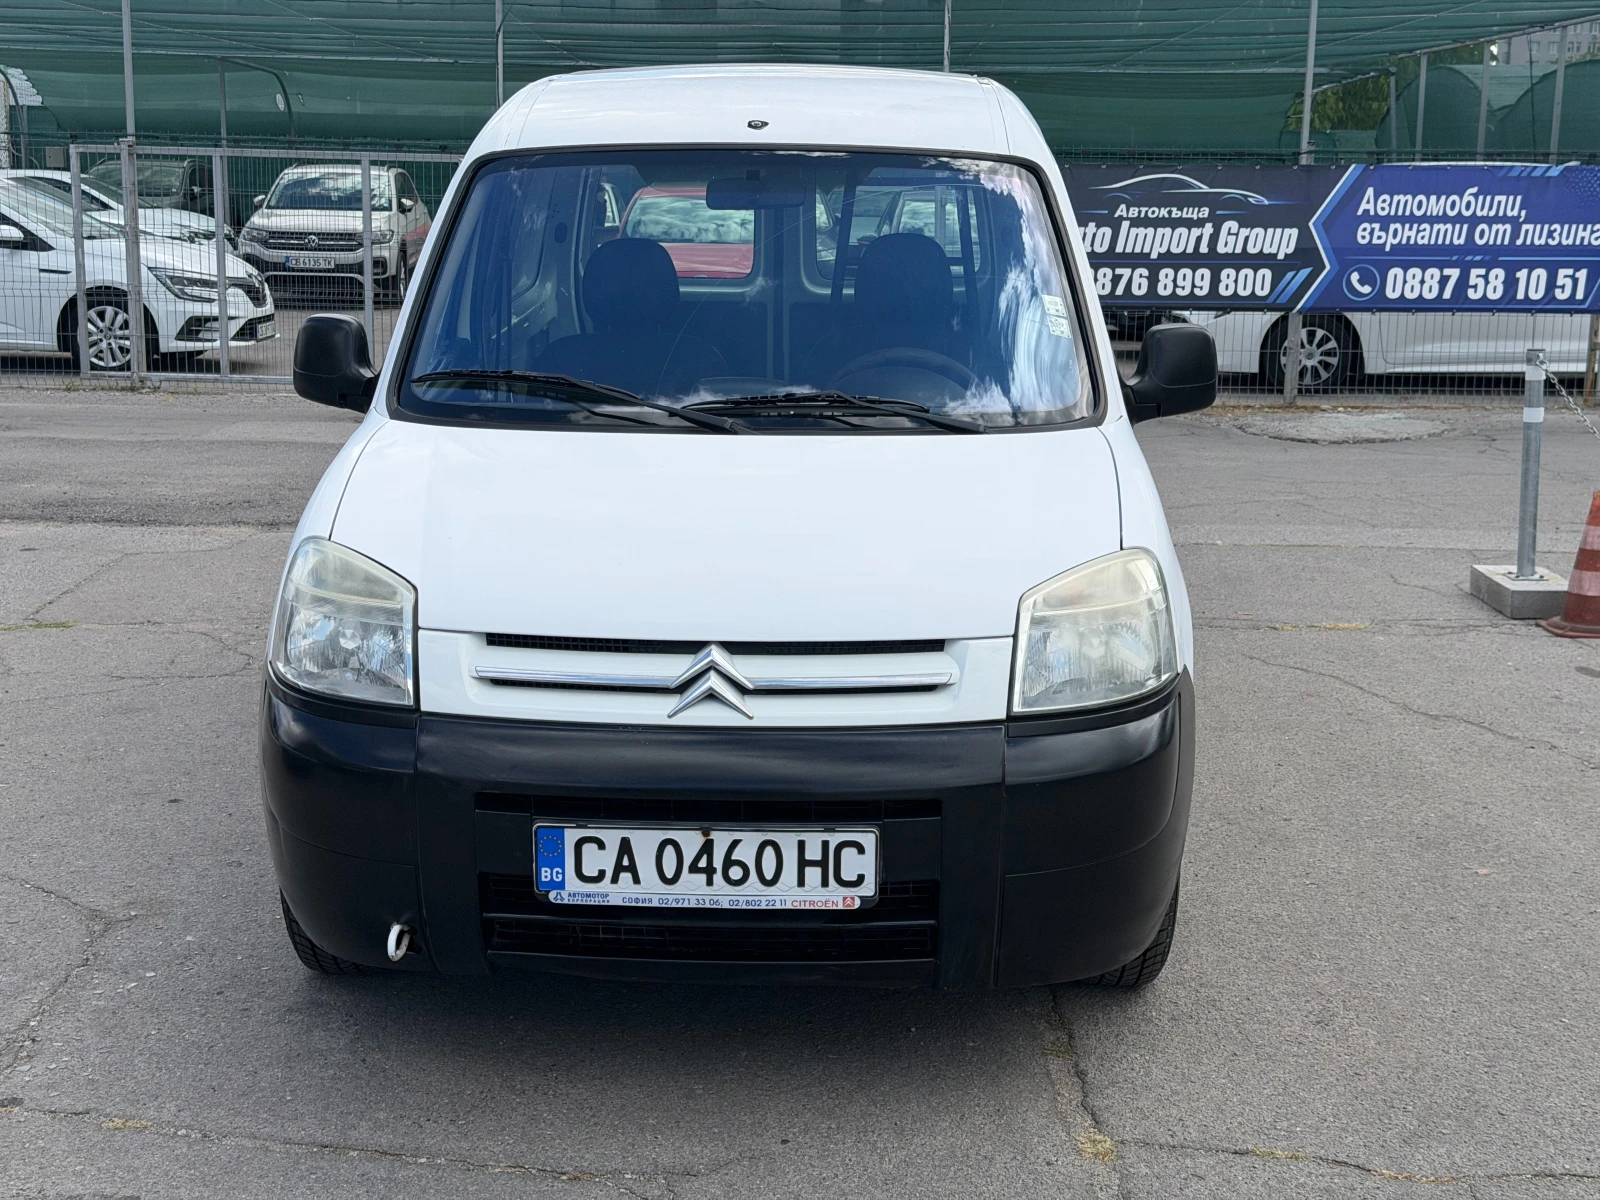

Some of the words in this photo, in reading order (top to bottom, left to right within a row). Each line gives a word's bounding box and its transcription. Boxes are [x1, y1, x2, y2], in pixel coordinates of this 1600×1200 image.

[1114, 203, 1210, 220] Автокъща
[1356, 186, 1527, 223] Автомобили,
[1078, 221, 1112, 254] to
[1115, 220, 1214, 260] Import
[1216, 220, 1299, 260] Group
[1356, 222, 1469, 252] върнати
[1474, 222, 1512, 246] от
[1090, 267, 1149, 296] 876
[1156, 267, 1211, 297] 899
[1218, 267, 1272, 297] 800
[1385, 266, 1460, 300] 0887
[1467, 267, 1505, 301] 58
[1515, 267, 1547, 301] 10
[1554, 267, 1588, 301] 51
[541, 867, 563, 882] BG
[573, 835, 641, 885] CA
[655, 837, 784, 888] 0460
[796, 838, 866, 888] HC
[567, 891, 610, 900] АВТОМОТОР
[622, 896, 653, 905] СОФИЯ
[658, 897, 691, 907] 02/971
[694, 898, 706, 906] 33
[728, 899, 763, 908] 02/802
[765, 899, 777, 907] 22
[780, 899, 787, 907] 11
[790, 898, 839, 908] CITROËN
